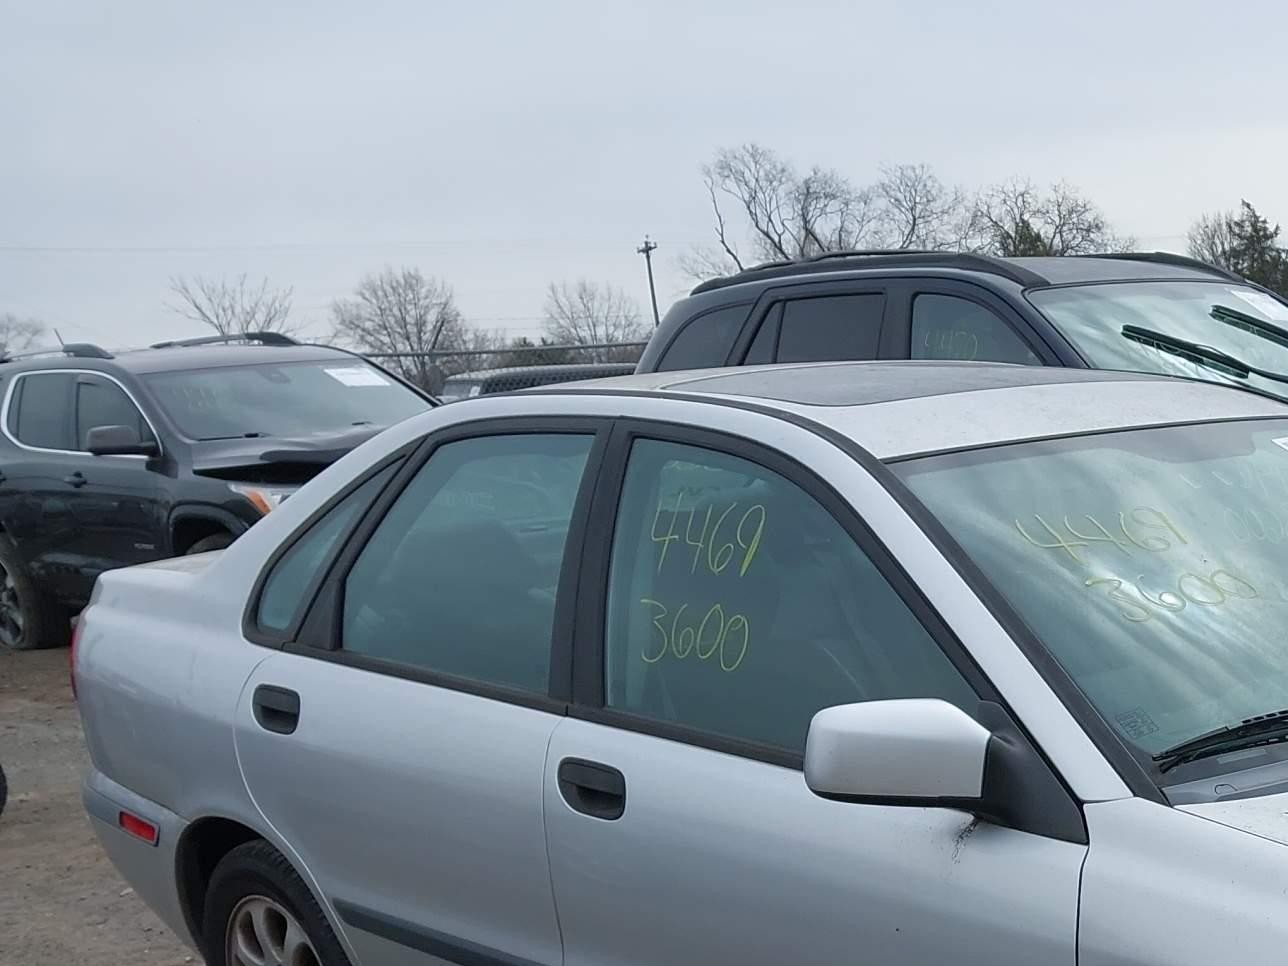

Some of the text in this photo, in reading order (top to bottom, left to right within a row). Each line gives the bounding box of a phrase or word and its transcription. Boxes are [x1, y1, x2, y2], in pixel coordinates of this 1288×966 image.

[651, 492, 766, 577] 4469
[1085, 569, 1258, 622] 3600
[640, 598, 749, 671] 3600
